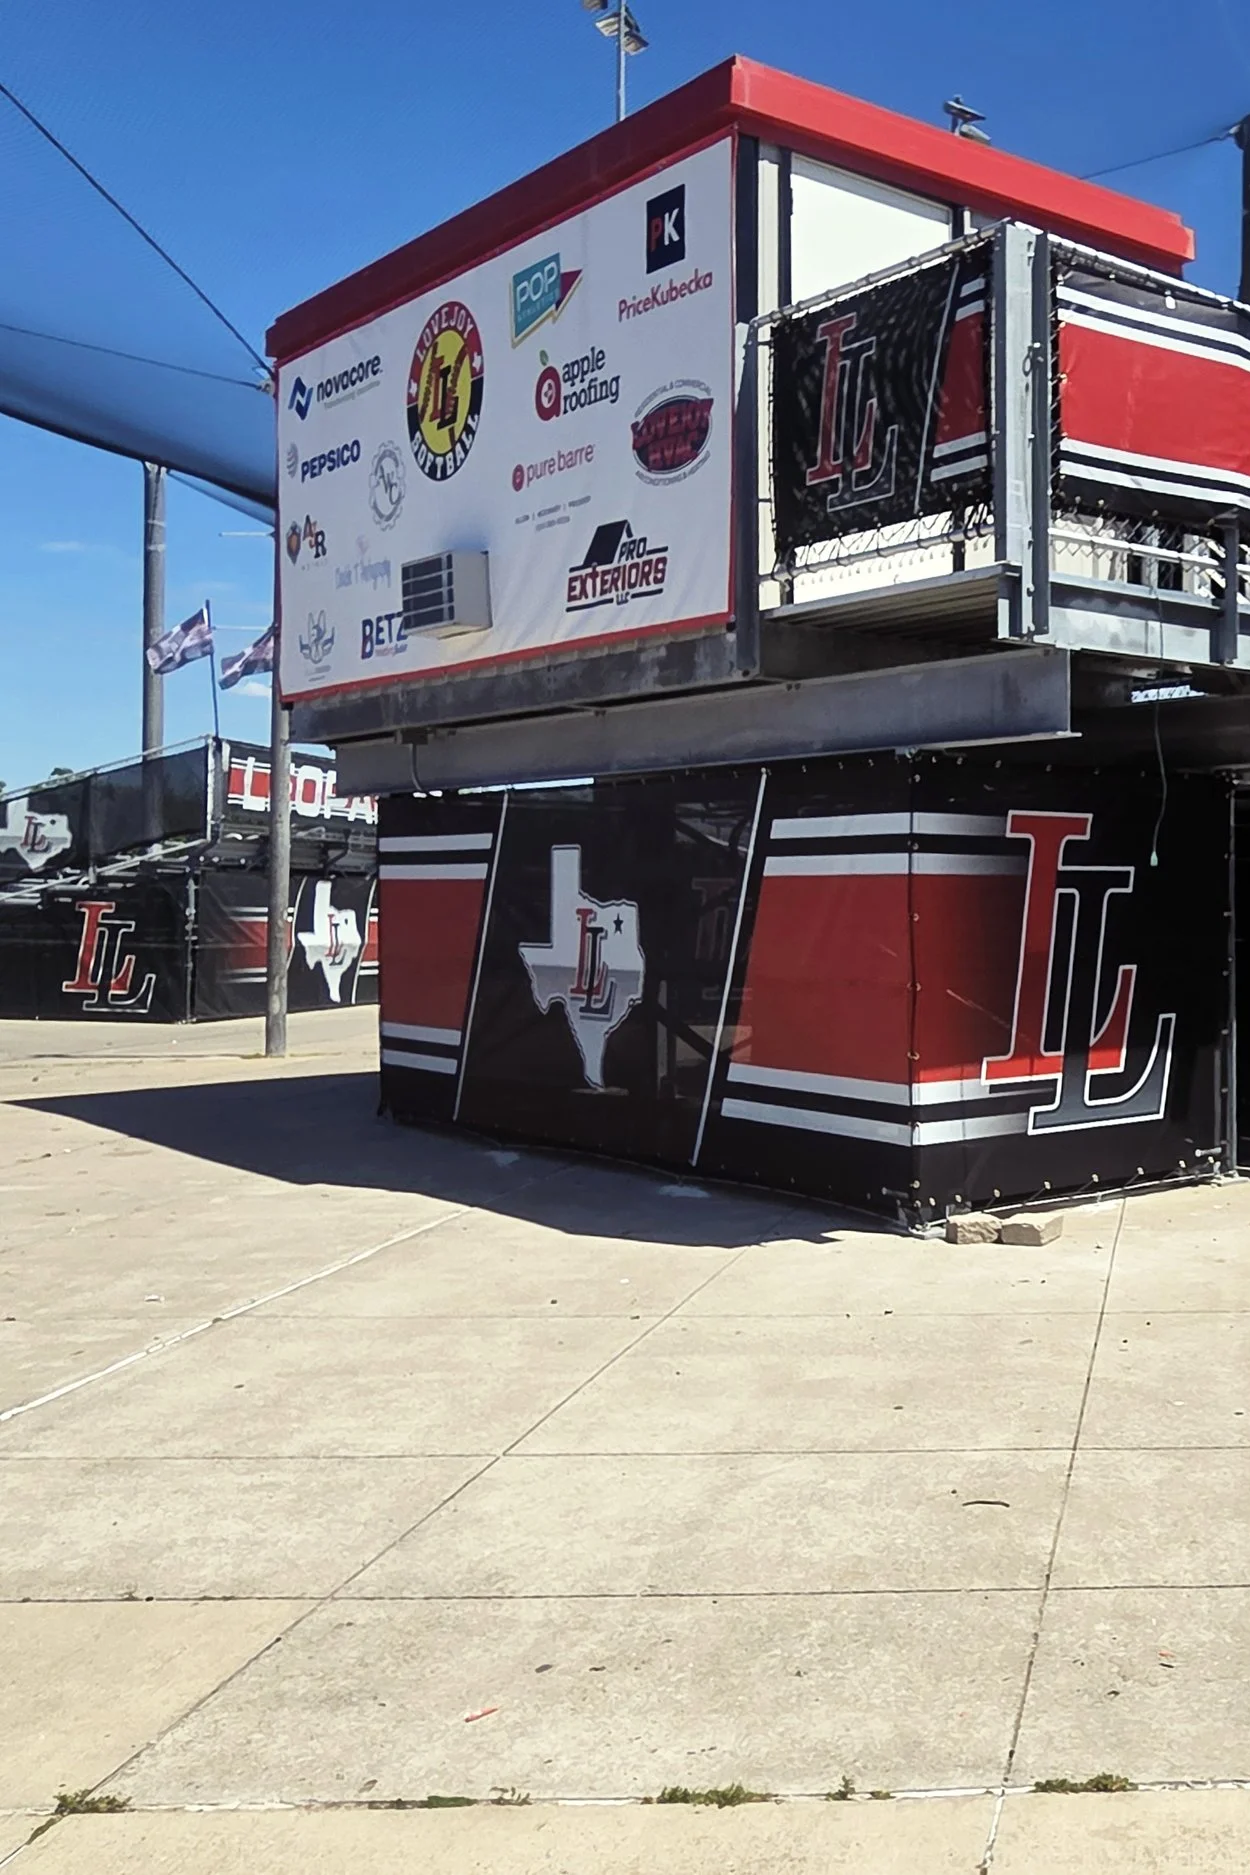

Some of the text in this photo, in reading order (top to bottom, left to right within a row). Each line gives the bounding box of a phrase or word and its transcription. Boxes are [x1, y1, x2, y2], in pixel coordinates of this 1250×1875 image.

[650, 208, 680, 252] PK
[516, 261, 559, 313] POP
[618, 268, 713, 323] PriceKubecka
[416, 305, 475, 363] LOVEJOY
[562, 346, 606, 387] apple
[562, 375, 621, 415] roofing
[806, 312, 899, 513] LL
[301, 439, 361, 483] PEPSICO
[411, 413, 480, 480] SOFTBALL
[526, 443, 596, 488] pure barre
[618, 537, 648, 564] PRO
[567, 556, 668, 603] EXTERIORS
[62, 901, 156, 1013] LL
[570, 908, 616, 1021] LL
[981, 810, 1176, 1136] LL
